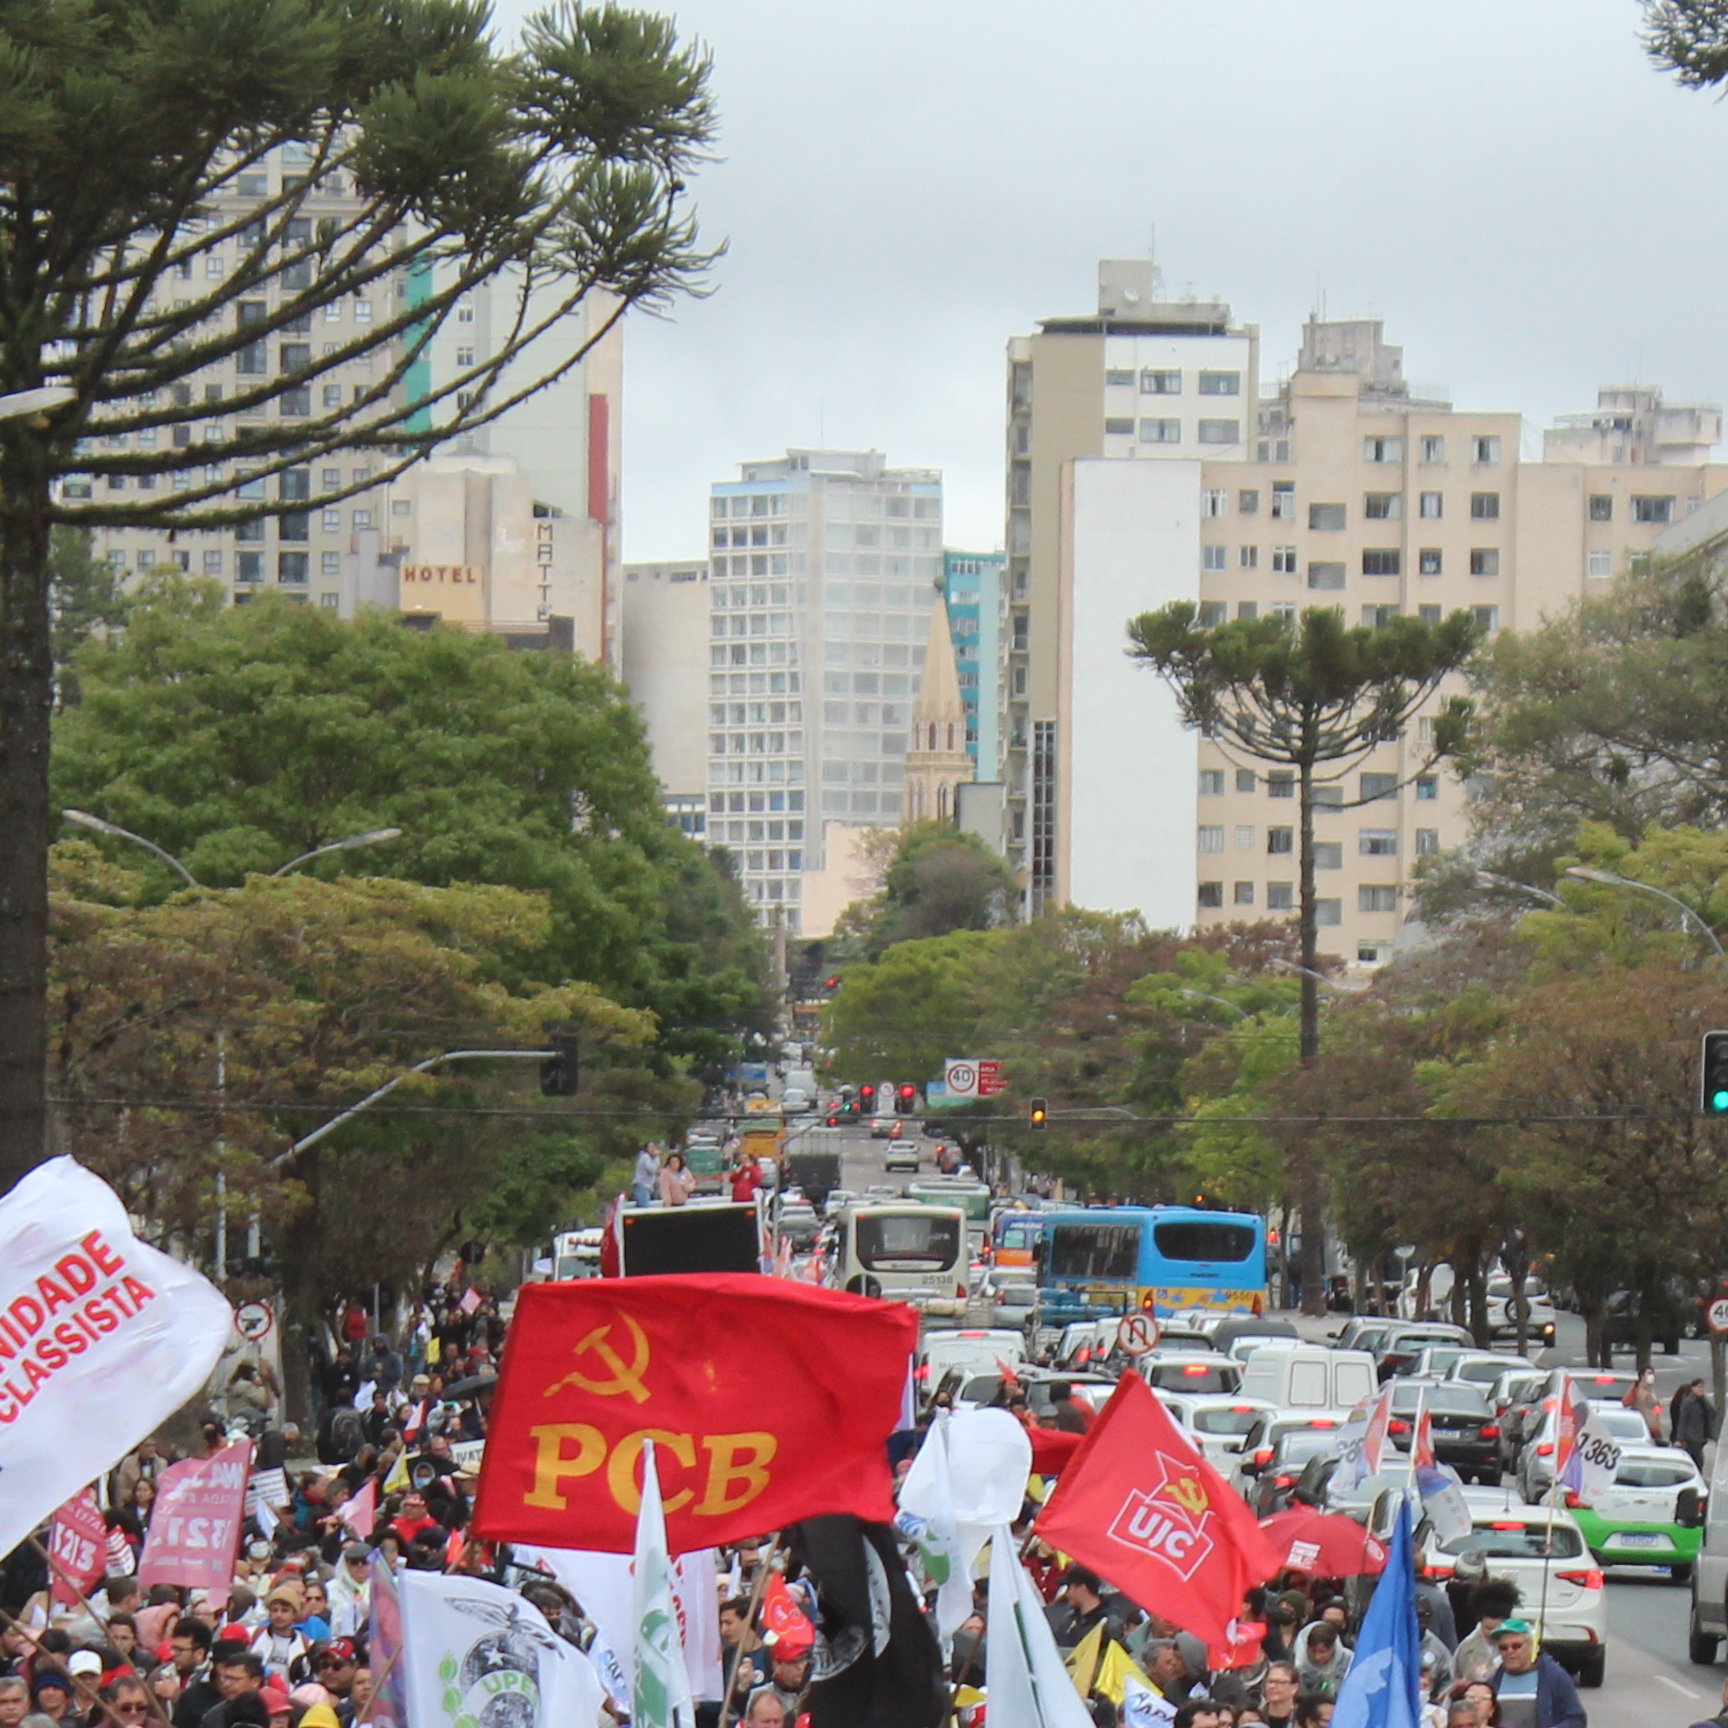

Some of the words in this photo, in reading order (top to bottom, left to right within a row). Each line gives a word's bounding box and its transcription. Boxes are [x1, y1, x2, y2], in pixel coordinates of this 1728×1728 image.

[404, 566, 476, 583] HOTEL
[952, 1070, 971, 1083] 40
[524, 1423, 778, 1517] PCB
[1128, 1505, 1195, 1558] UJC
